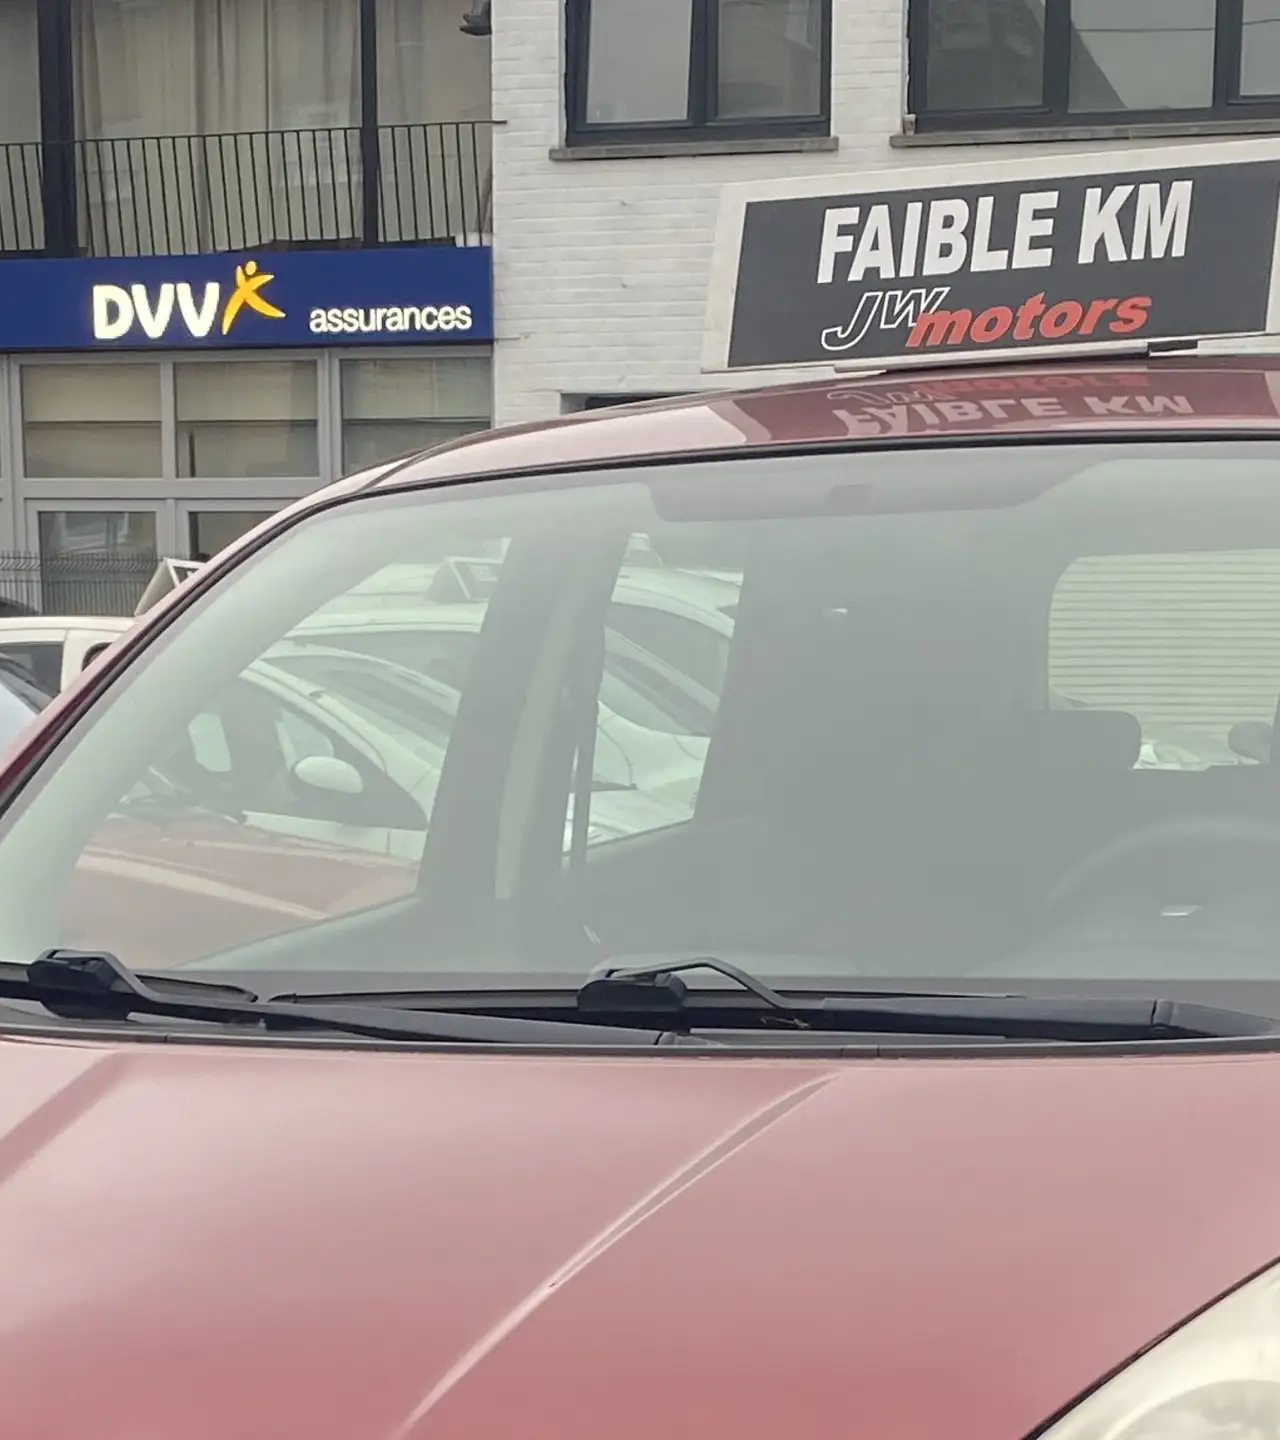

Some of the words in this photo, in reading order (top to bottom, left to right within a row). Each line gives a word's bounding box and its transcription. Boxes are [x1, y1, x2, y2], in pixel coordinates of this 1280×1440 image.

[817, 190, 1060, 284] FAIBLE
[1078, 179, 1195, 264] KM
[92, 282, 221, 340] DVV
[308, 303, 473, 334] assurances
[821, 287, 952, 351] JW
[904, 292, 1154, 348] motors
